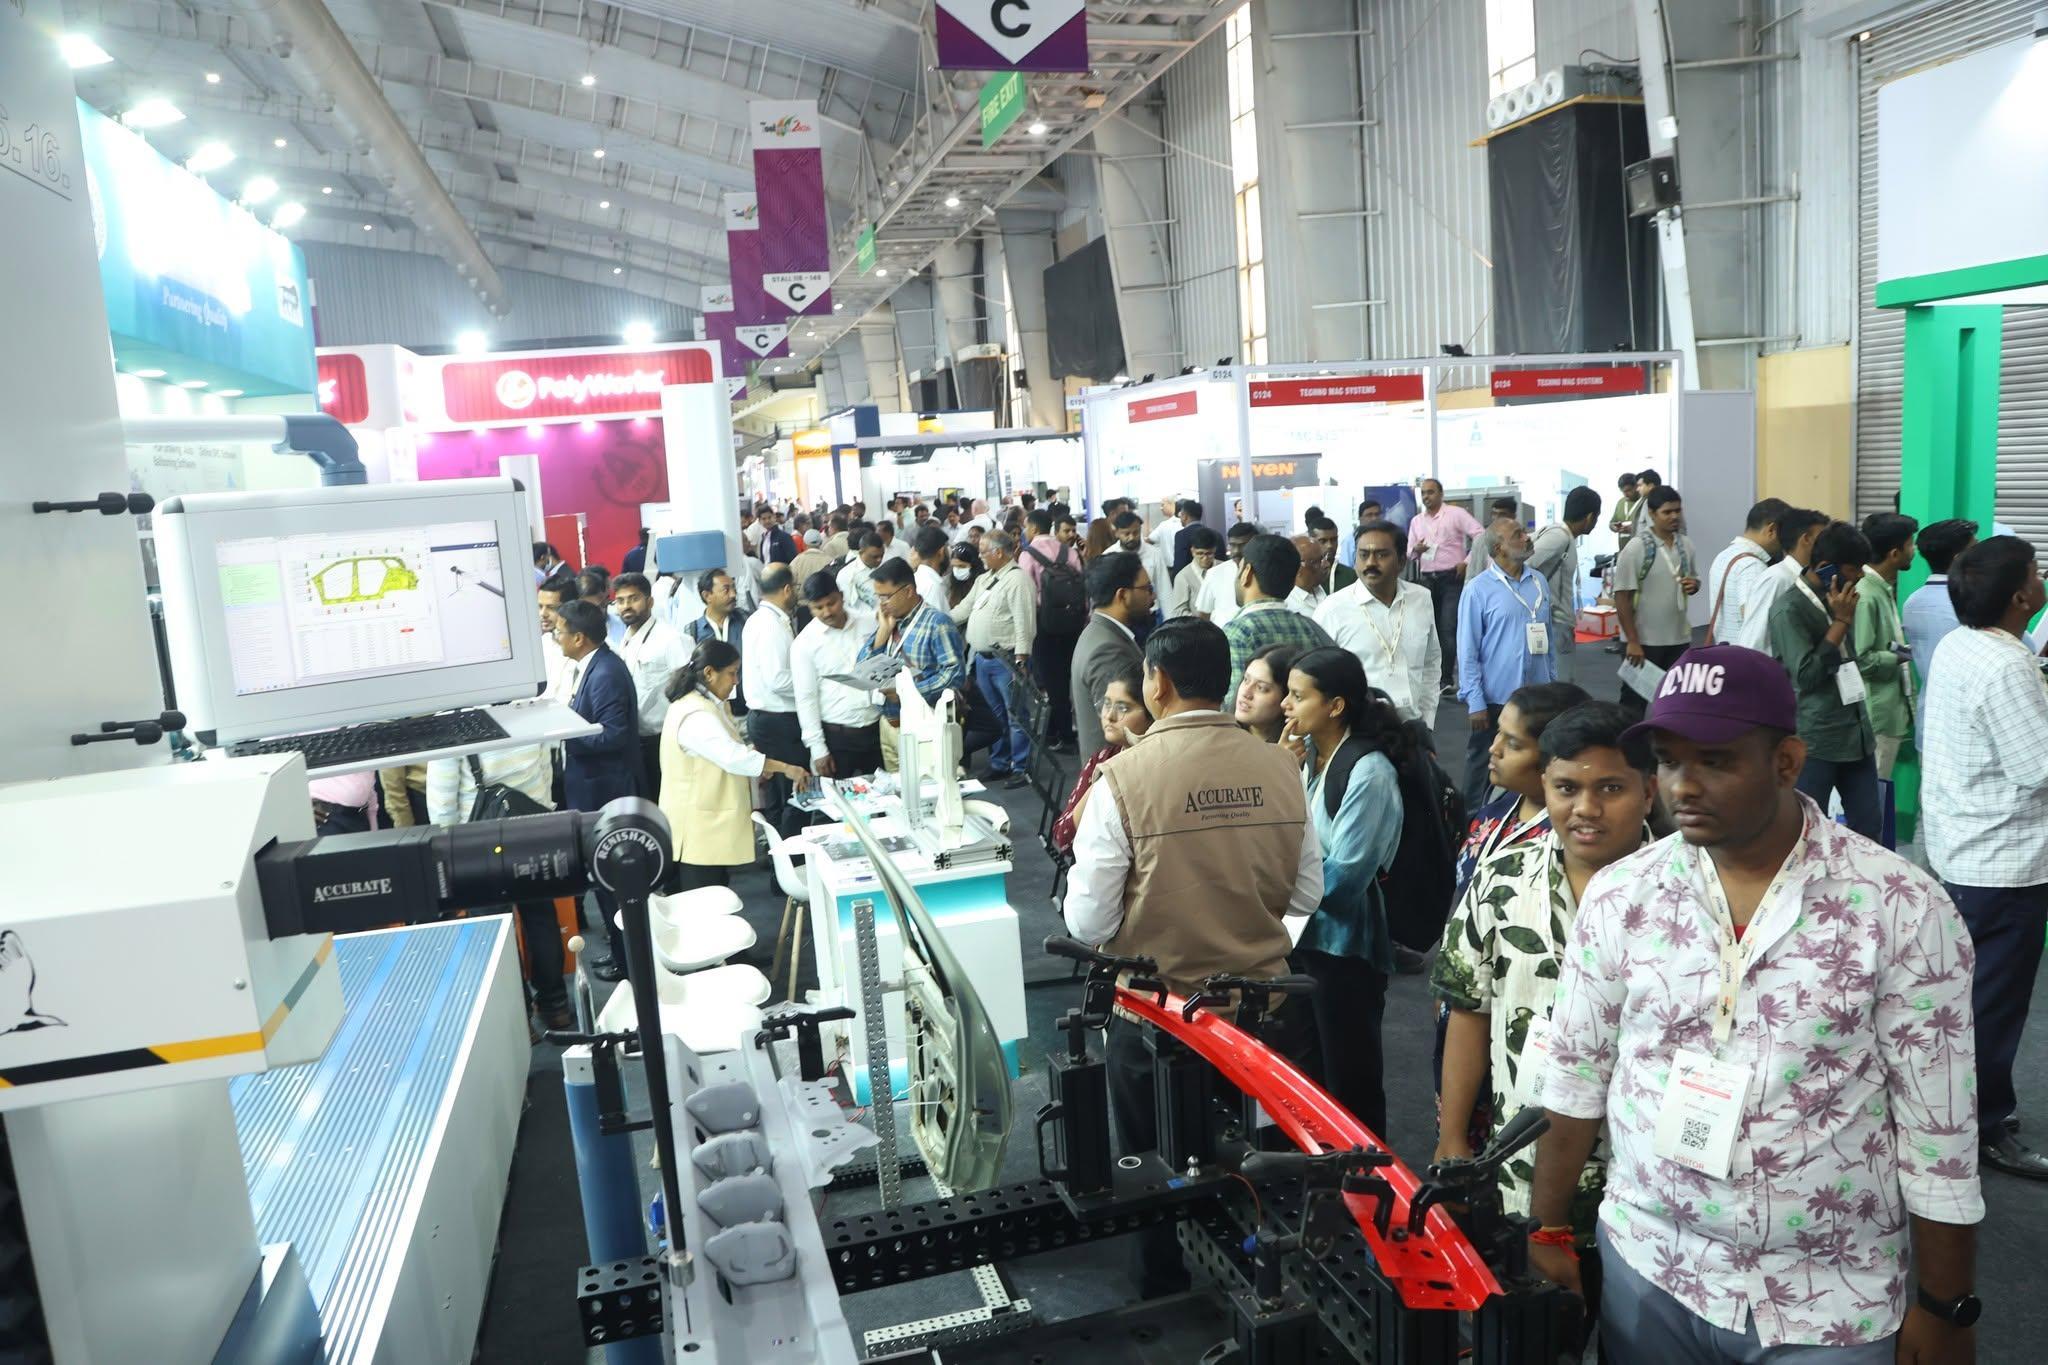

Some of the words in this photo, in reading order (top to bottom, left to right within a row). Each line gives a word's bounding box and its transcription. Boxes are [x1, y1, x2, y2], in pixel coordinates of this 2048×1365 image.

[990, 0, 1032, 38] C
[982, 93, 1000, 129] FIRE
[999, 71, 1018, 110] EXIT
[788, 283, 807, 302] C
[755, 334, 769, 348] C
[1213, 370, 1233, 379] C124
[1345, 385, 1377, 396] SYSTEMS
[1185, 786, 1264, 813] ACCURATE
[598, 831, 657, 860] RENISHAW
[313, 878, 393, 903] ACCURATE
[1673, 1154, 1705, 1171] VISITOR
